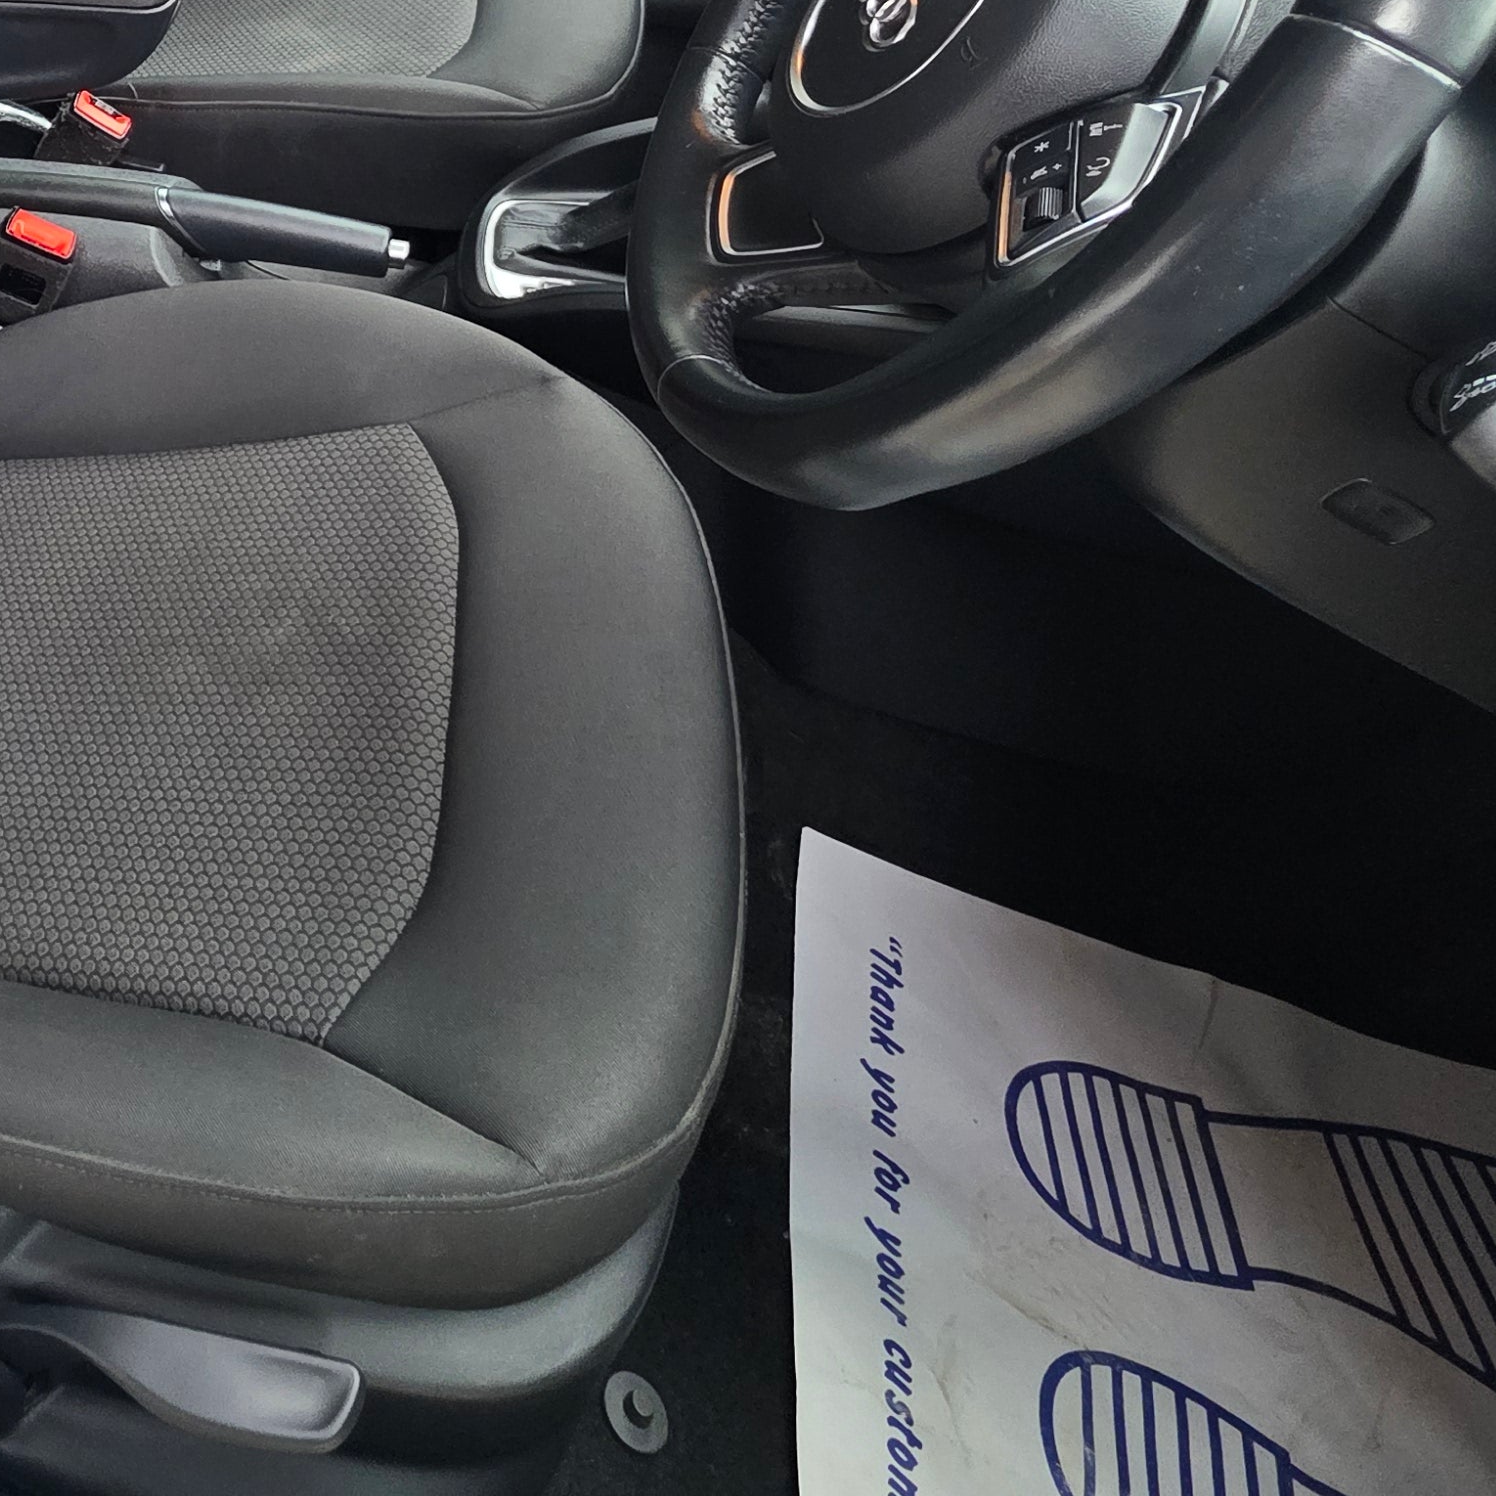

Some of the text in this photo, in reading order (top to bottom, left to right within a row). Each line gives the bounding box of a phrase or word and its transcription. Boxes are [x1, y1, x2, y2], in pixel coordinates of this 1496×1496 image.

[859, 1058, 898, 1138] you
[872, 1149, 910, 1215] for
[863, 1215, 908, 1328] your
